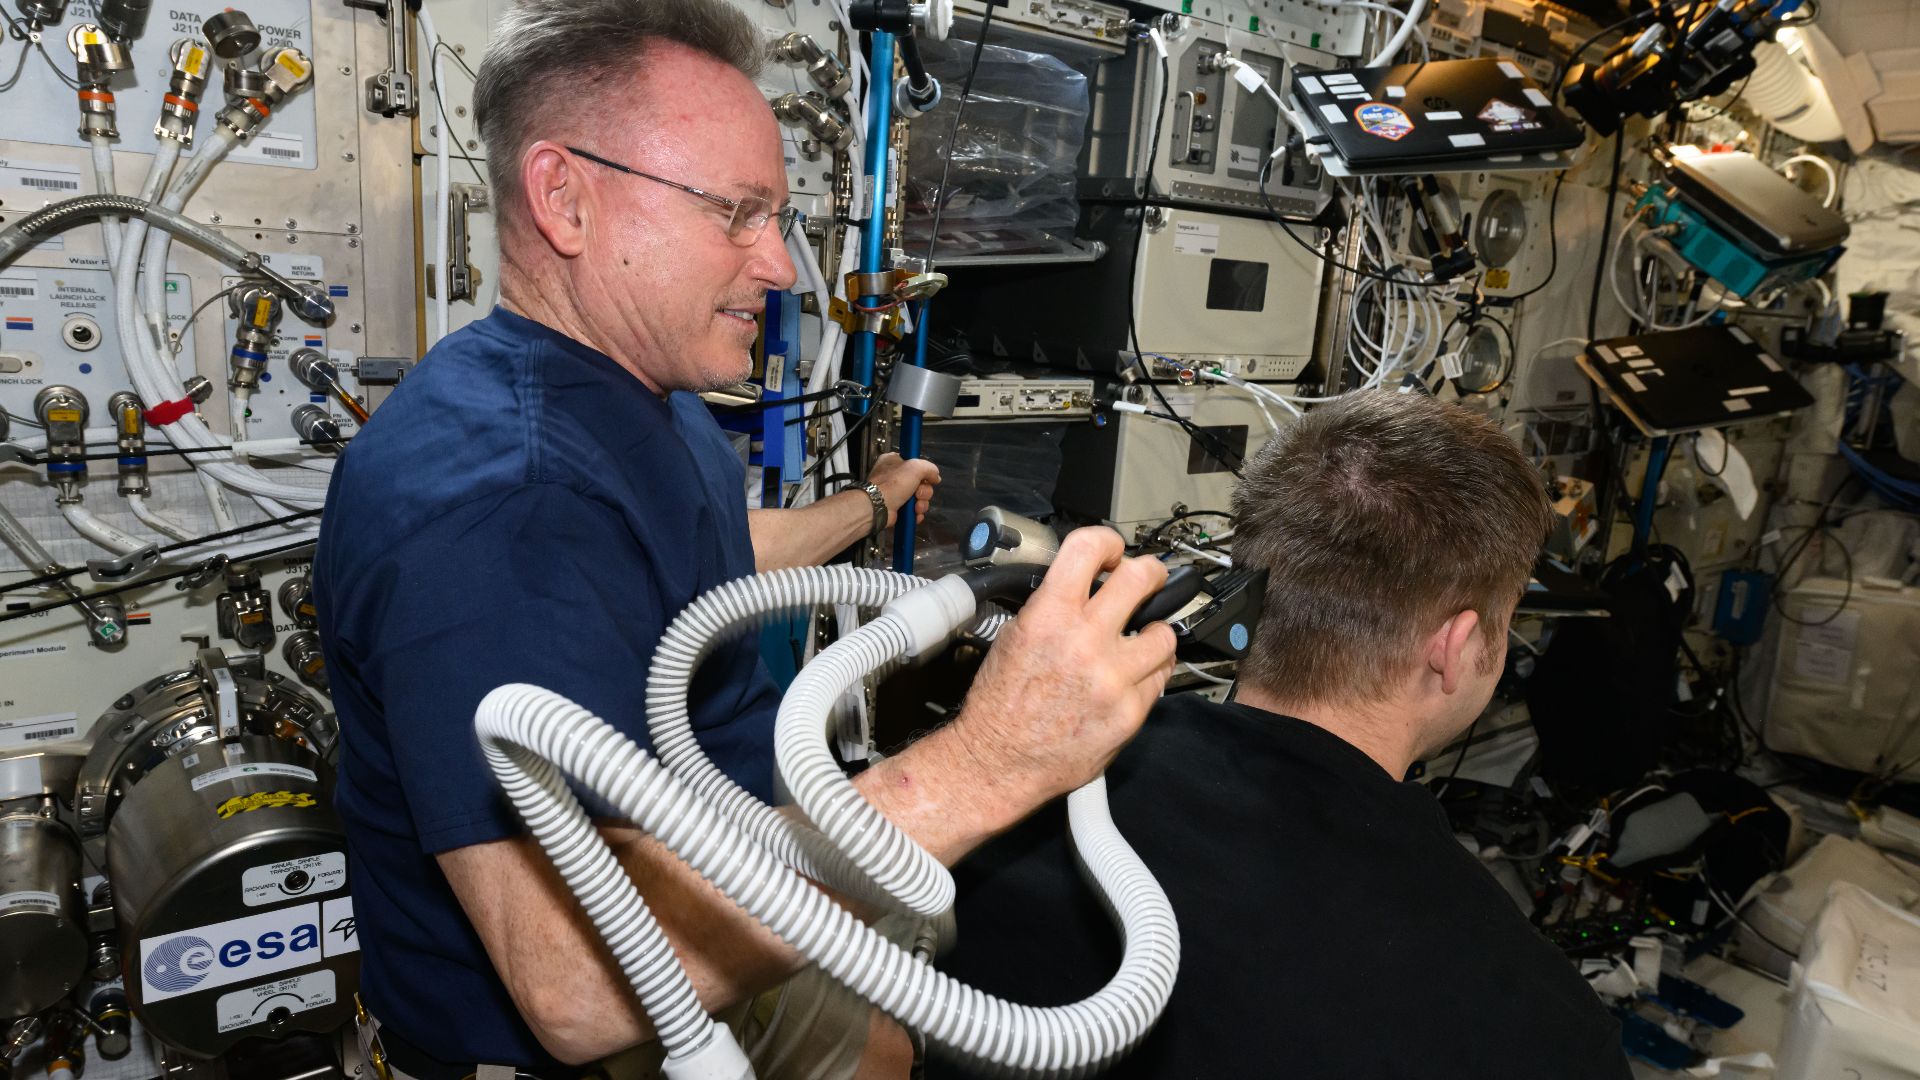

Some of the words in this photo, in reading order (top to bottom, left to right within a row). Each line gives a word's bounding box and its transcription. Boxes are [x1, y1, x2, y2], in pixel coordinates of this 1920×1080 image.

[70, 7, 92, 18] J21
[169, 10, 202, 23] DATA
[172, 23, 199, 34] J211
[257, 24, 301, 39] POWER
[0, 648, 35, 657] periment
[37, 645, 66, 653] Module
[317, 869, 344, 878] FORWARD
[244, 882, 277, 893] BACKWARD
[219, 923, 318, 968] esa
[305, 998, 332, 1009] FORWARD
[219, 1019, 252, 1031] BACKWARD
